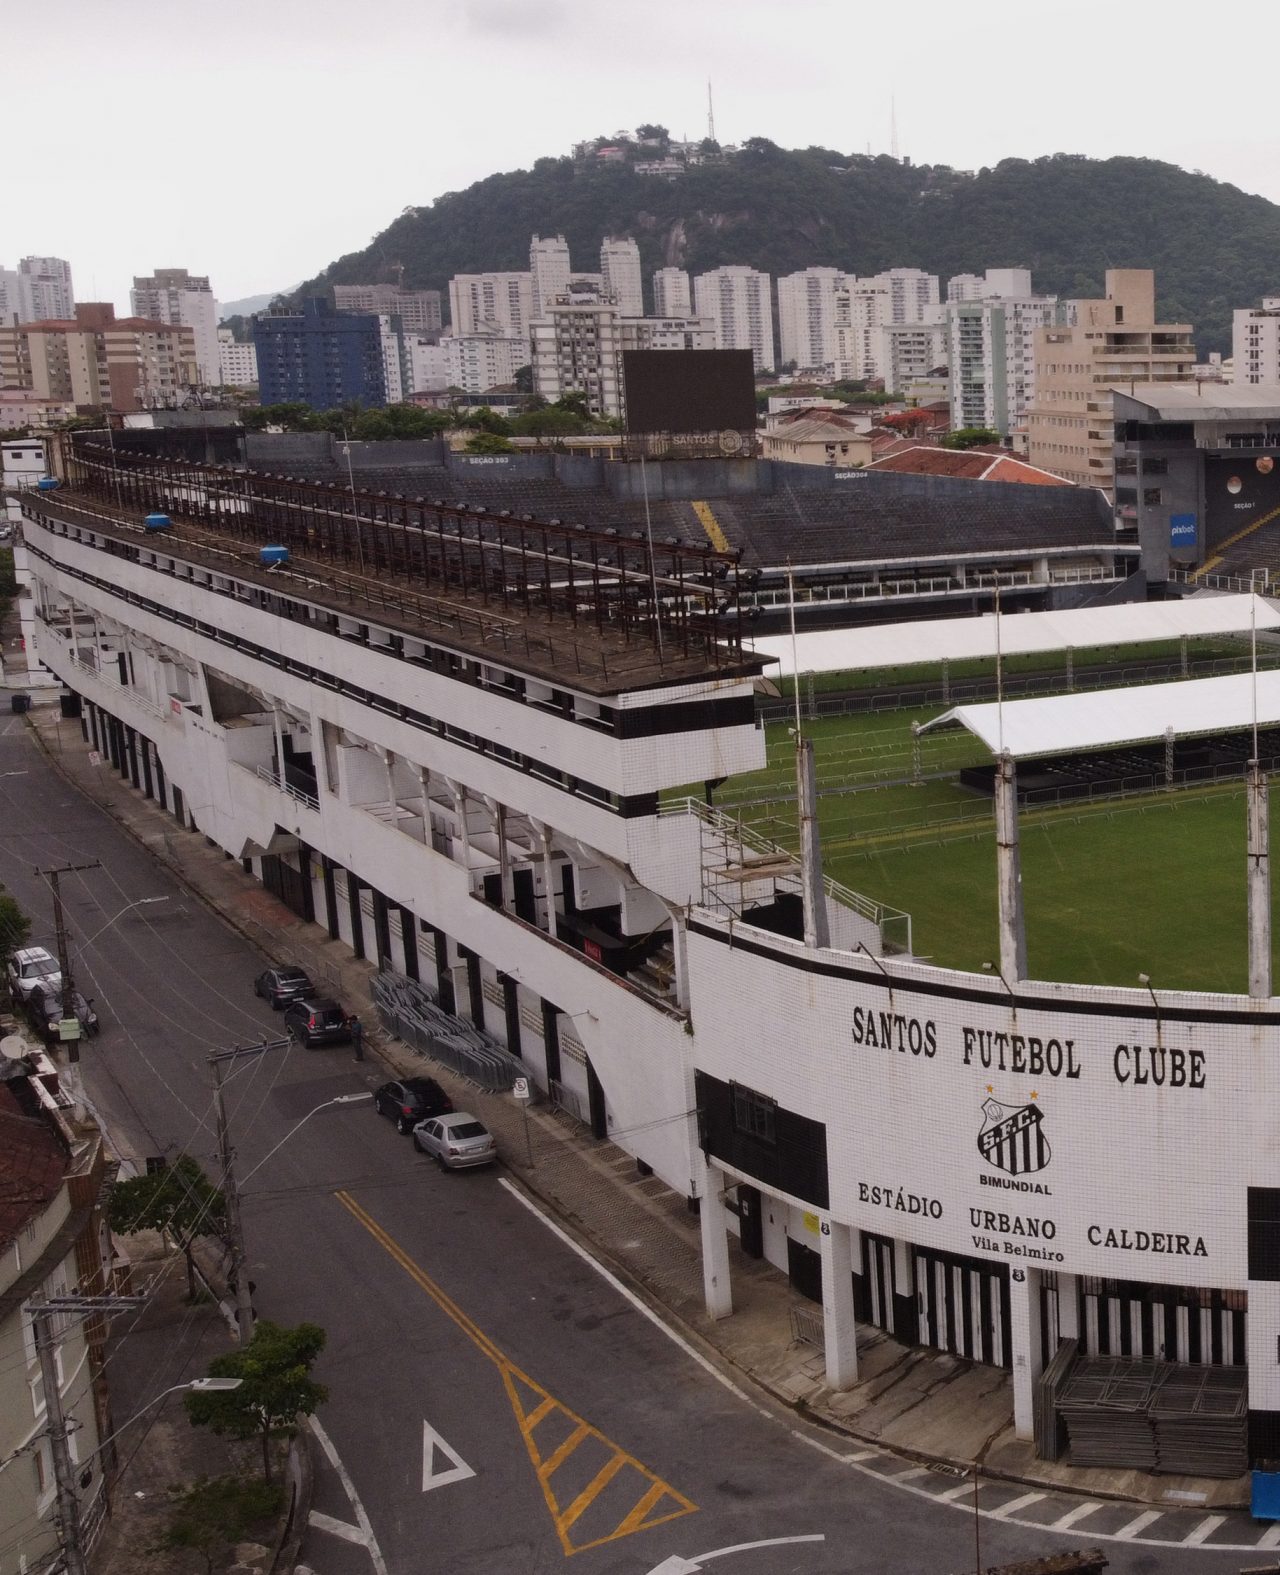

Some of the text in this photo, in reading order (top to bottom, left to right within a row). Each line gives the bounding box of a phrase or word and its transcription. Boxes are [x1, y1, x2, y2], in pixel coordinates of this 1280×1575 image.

[672, 434, 715, 445] SANTOS
[1171, 524, 1195, 536] pixbet
[852, 1006, 1206, 1089] SANTOS FUTEBOL CLUBE
[983, 1109, 1037, 1151] S.F.C.
[979, 1174, 1053, 1196] BIMUNDIAL
[858, 1182, 1209, 1257] ESTÁDIO URBANO CALDEIRA
[972, 1235, 1065, 1263] Vila Belmiro
